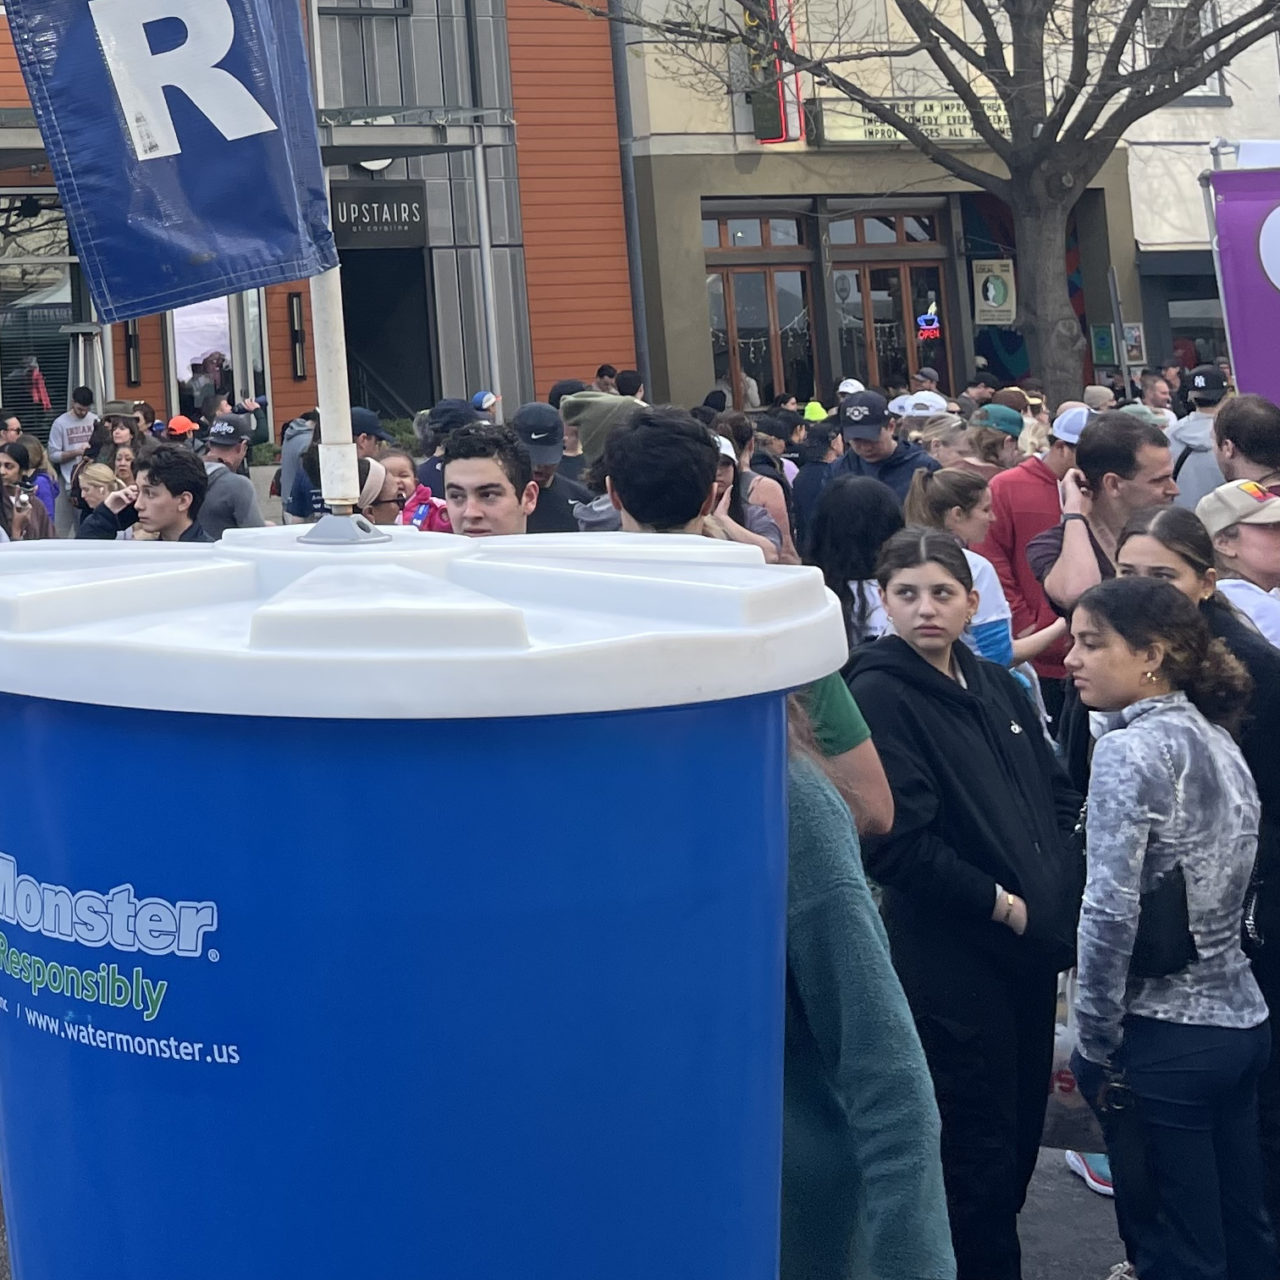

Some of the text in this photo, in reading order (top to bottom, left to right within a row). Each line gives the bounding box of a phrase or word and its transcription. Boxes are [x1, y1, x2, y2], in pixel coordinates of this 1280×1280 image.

[923, 103, 934, 113] AN
[941, 103, 967, 113] IMPRO
[981, 103, 1002, 113] THEA
[864, 128, 897, 139] IMPROV
[949, 128, 964, 138] ALL
[337, 202, 421, 223] UPSTAIRS
[918, 329, 940, 340] OPEN
[66, 424, 94, 436] INDIAN
[24, 1006, 241, 1065] www.watermonster.us
